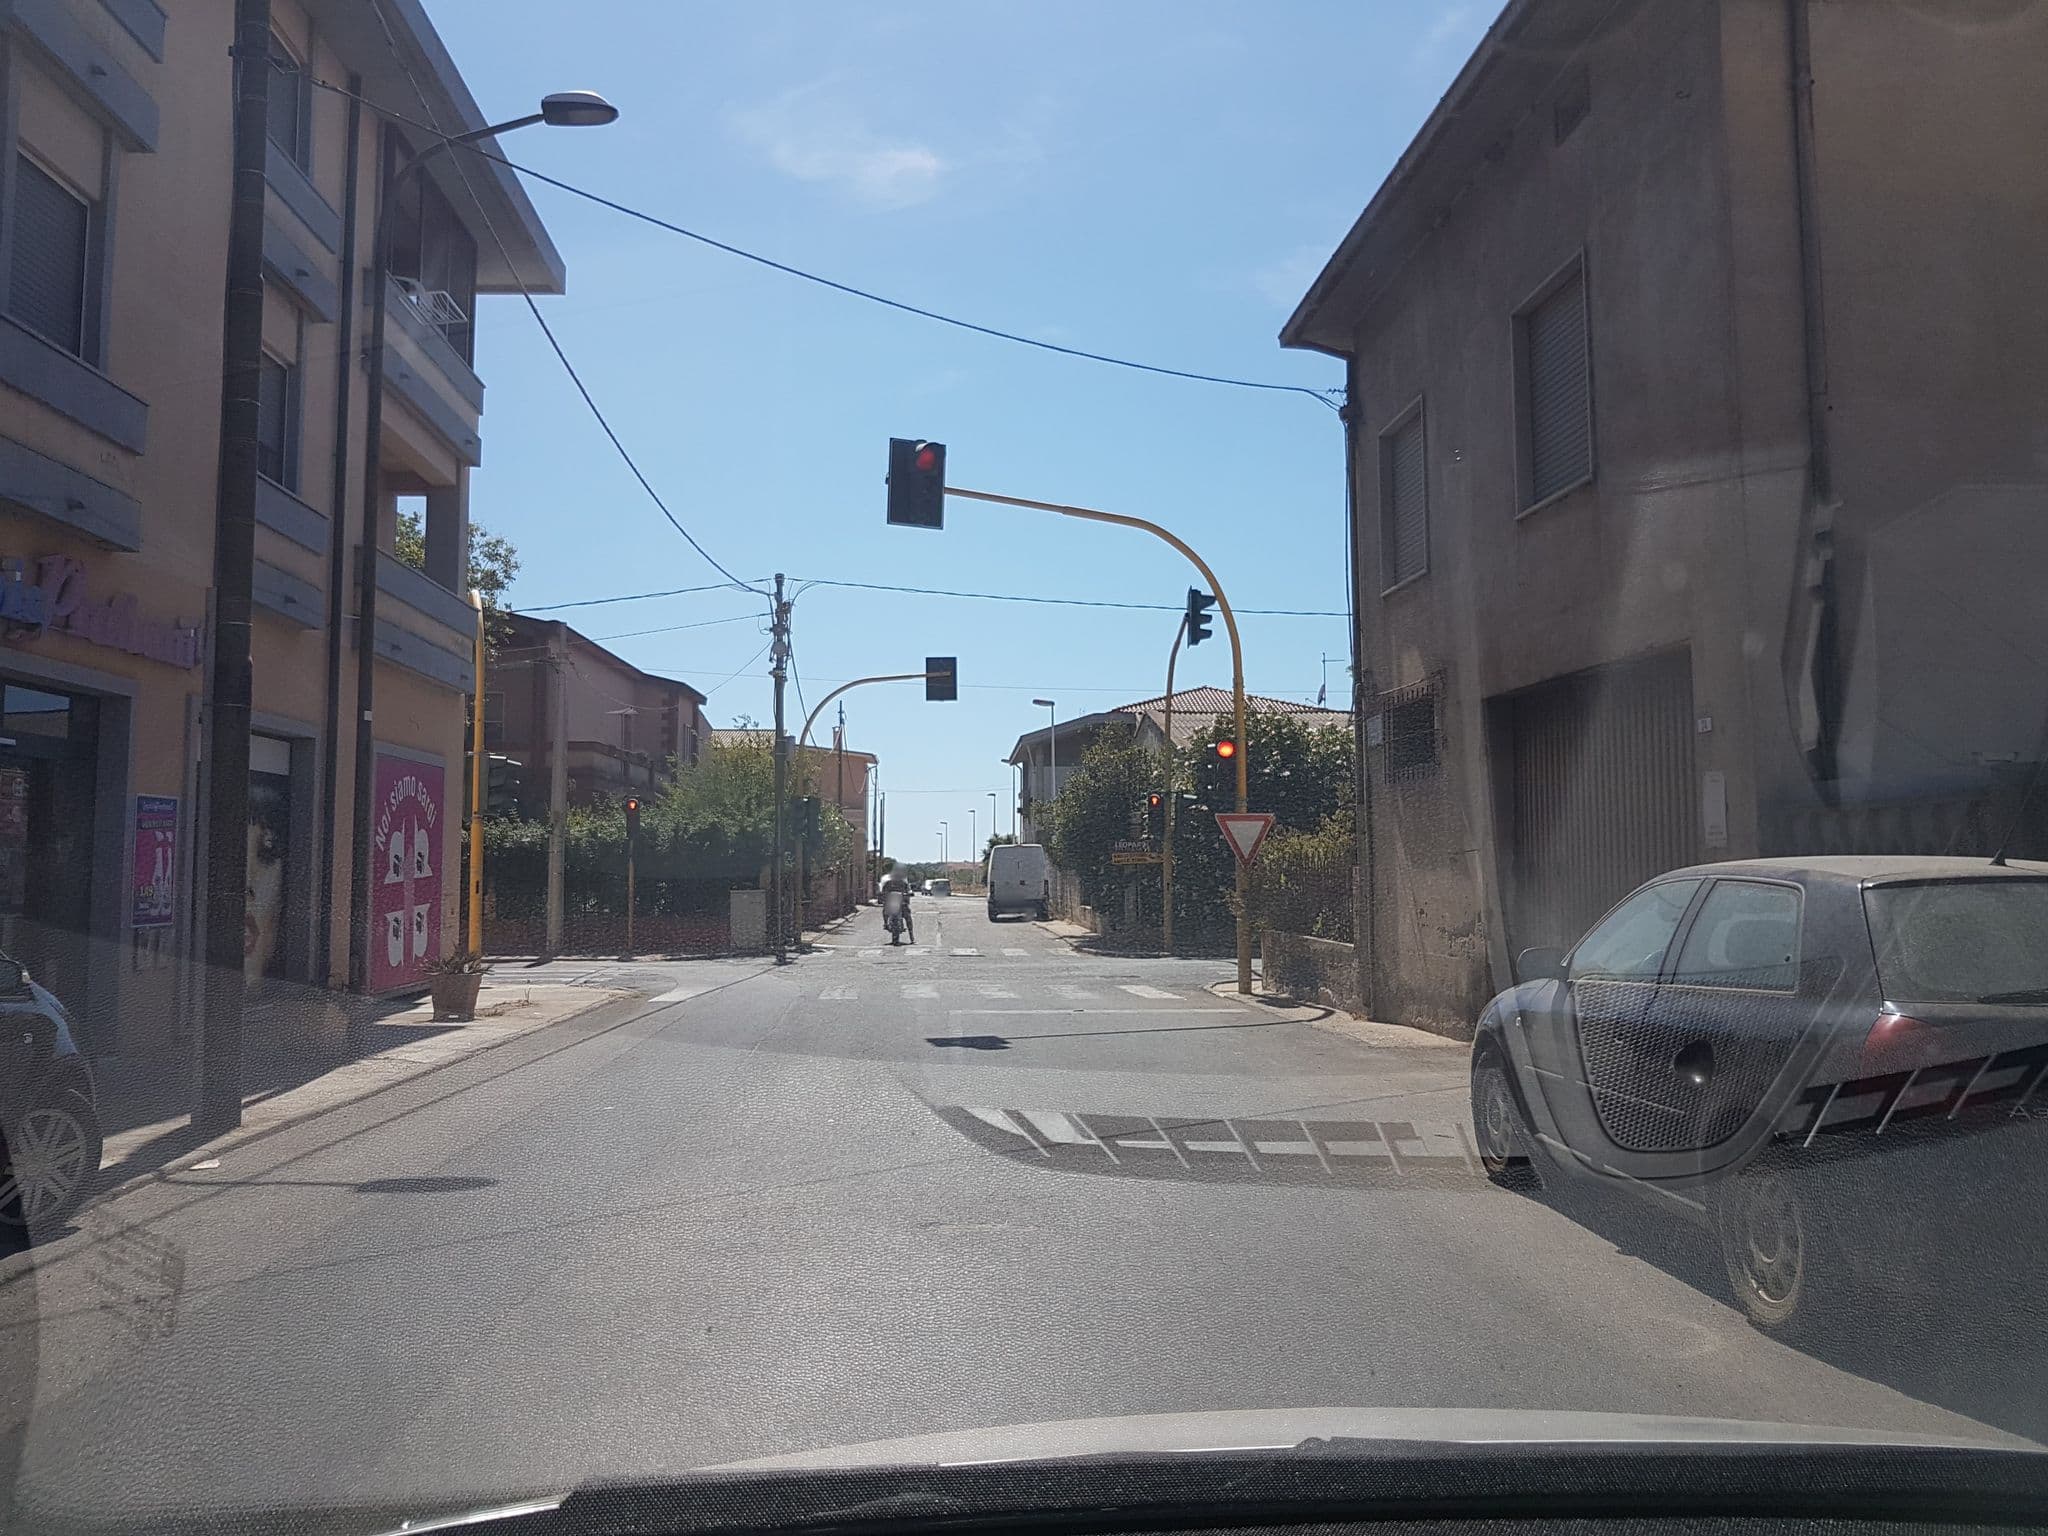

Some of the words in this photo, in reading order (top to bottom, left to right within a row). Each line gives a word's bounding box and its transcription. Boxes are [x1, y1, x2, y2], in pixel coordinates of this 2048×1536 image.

[376, 801, 391, 851] Noi
[390, 775, 416, 811] siamo
[417, 781, 437, 828] sardi
